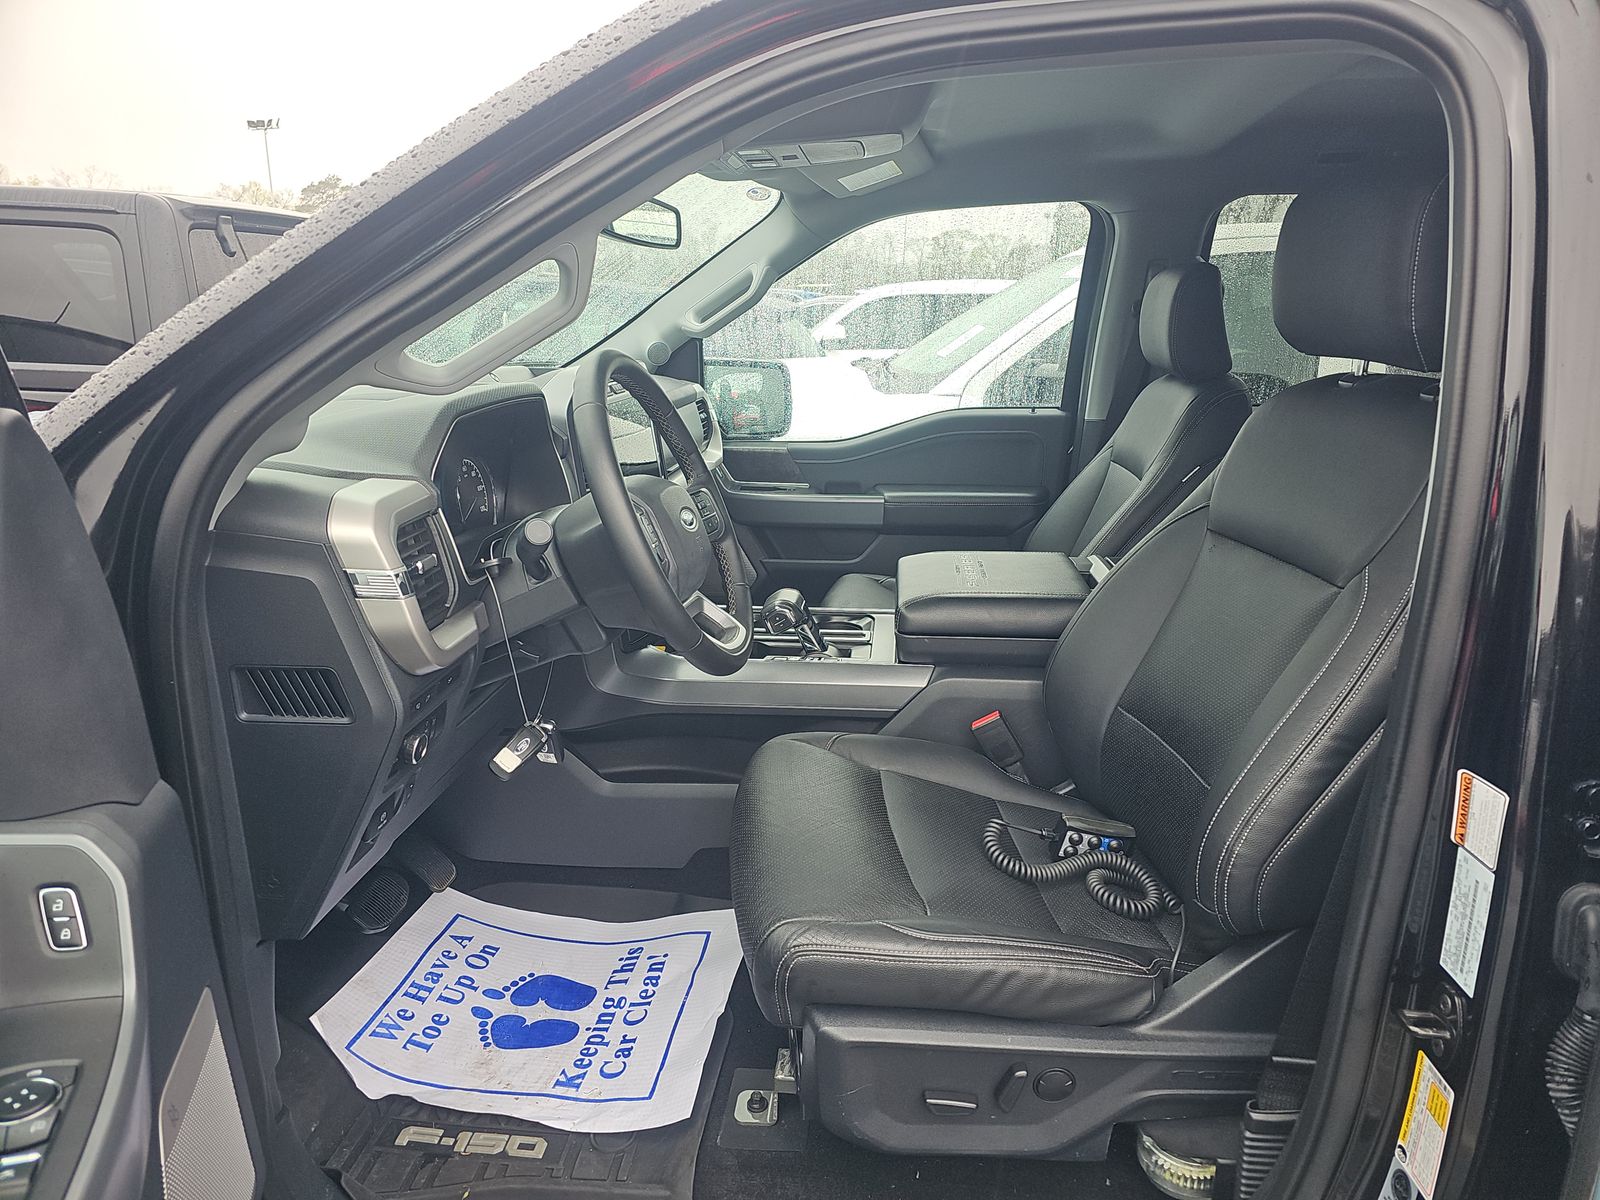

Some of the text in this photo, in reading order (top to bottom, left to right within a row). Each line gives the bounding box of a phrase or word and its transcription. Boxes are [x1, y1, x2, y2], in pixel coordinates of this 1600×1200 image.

[1459, 776, 1473, 829] WARNING
[368, 932, 475, 1041] We Have A
[402, 943, 501, 1053] Toe Up On
[554, 945, 644, 1091] Keeping This
[599, 952, 670, 1080] Car Clean!
[394, 1125, 548, 1159] F-150
